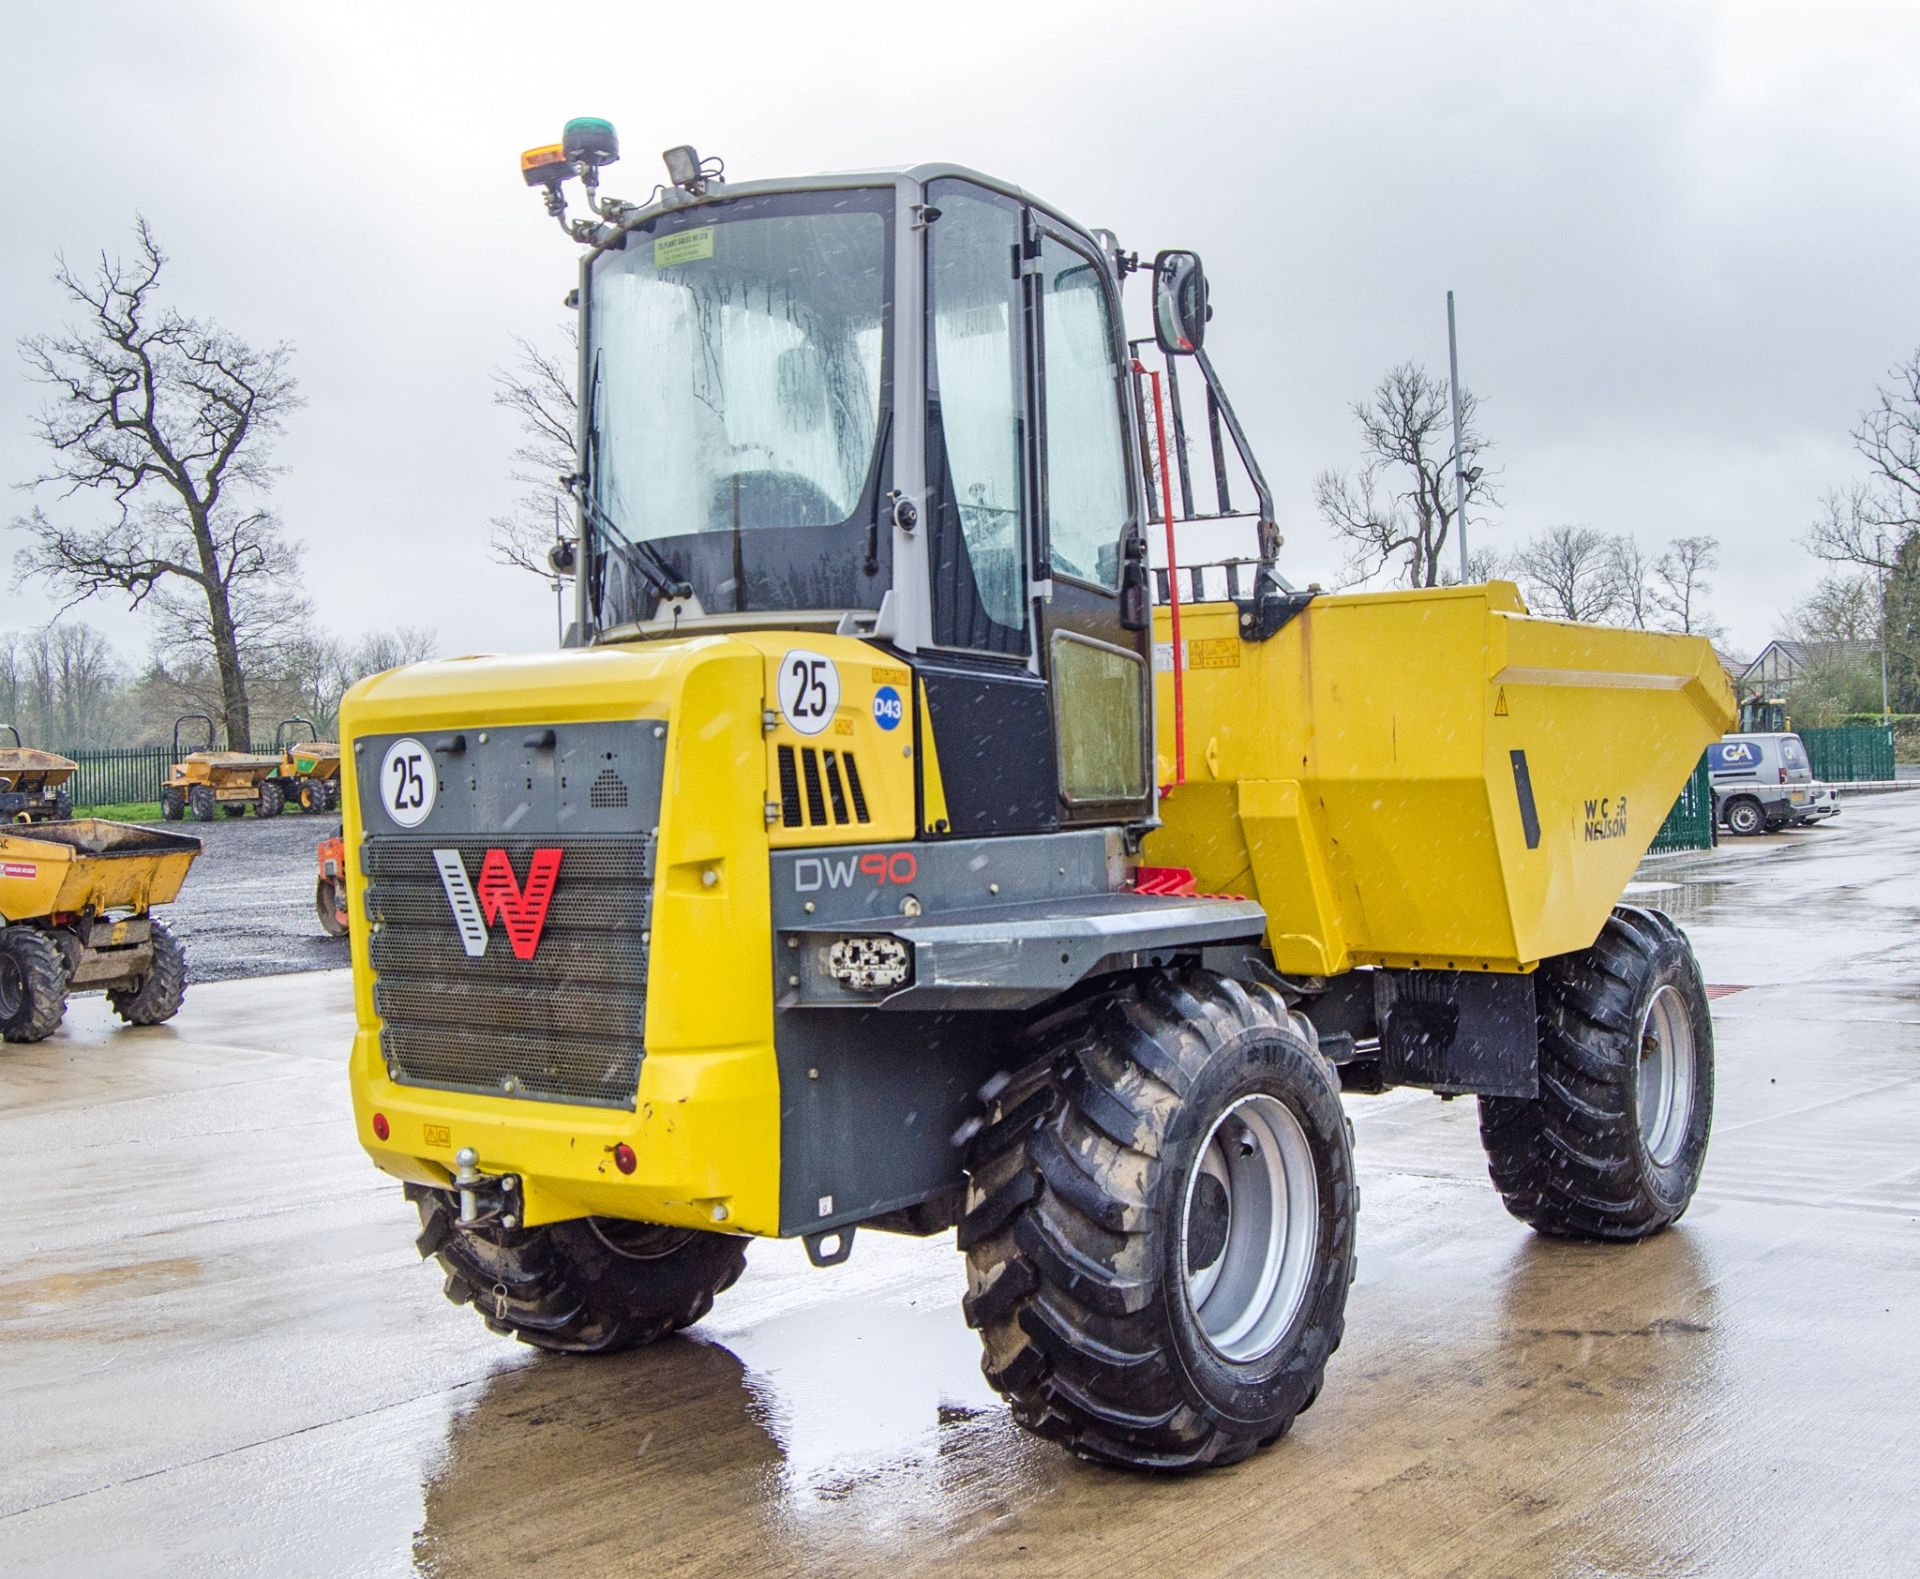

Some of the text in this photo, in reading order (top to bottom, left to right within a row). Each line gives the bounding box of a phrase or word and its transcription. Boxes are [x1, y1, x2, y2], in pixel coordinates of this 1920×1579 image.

[792, 660, 827, 717] 25
[874, 697, 901, 719] D43
[393, 755, 424, 810] 25
[795, 851, 918, 892] DW90
